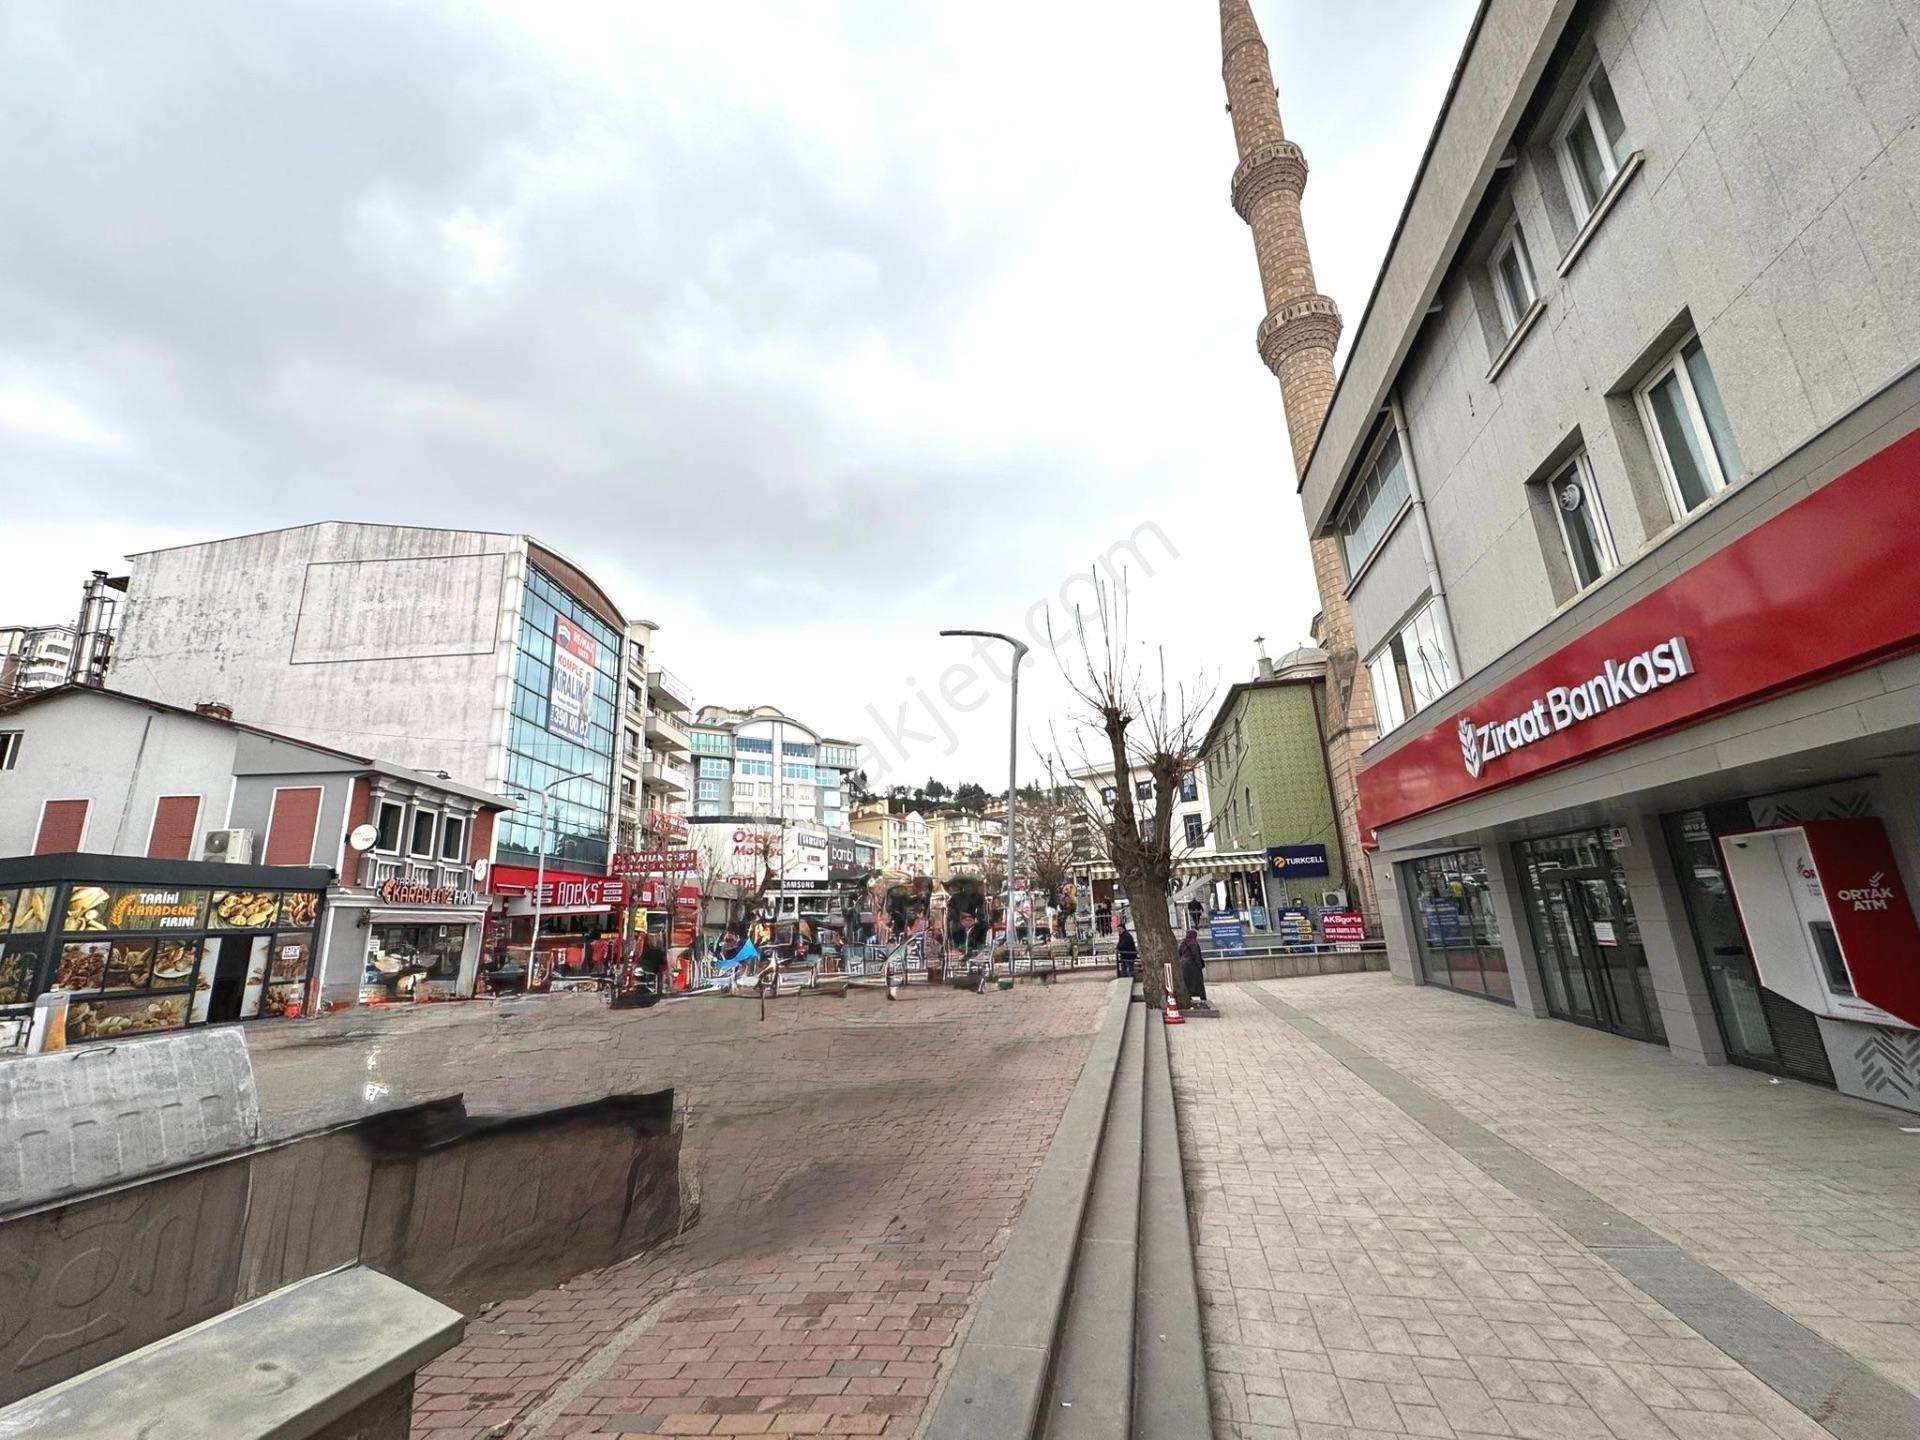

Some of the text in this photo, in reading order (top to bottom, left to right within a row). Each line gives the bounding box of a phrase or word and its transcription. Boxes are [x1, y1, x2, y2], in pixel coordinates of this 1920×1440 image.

[1478, 636, 1695, 762] Ziraat Bankası
[1285, 856, 1325, 865] TURKCELL
[782, 881, 815, 889] SAMSUNG
[139, 891, 180, 904] TARİHİ
[1837, 887, 1895, 900] ORTAK
[1853, 900, 1888, 911] ATM
[160, 917, 195, 927] FIRINI
